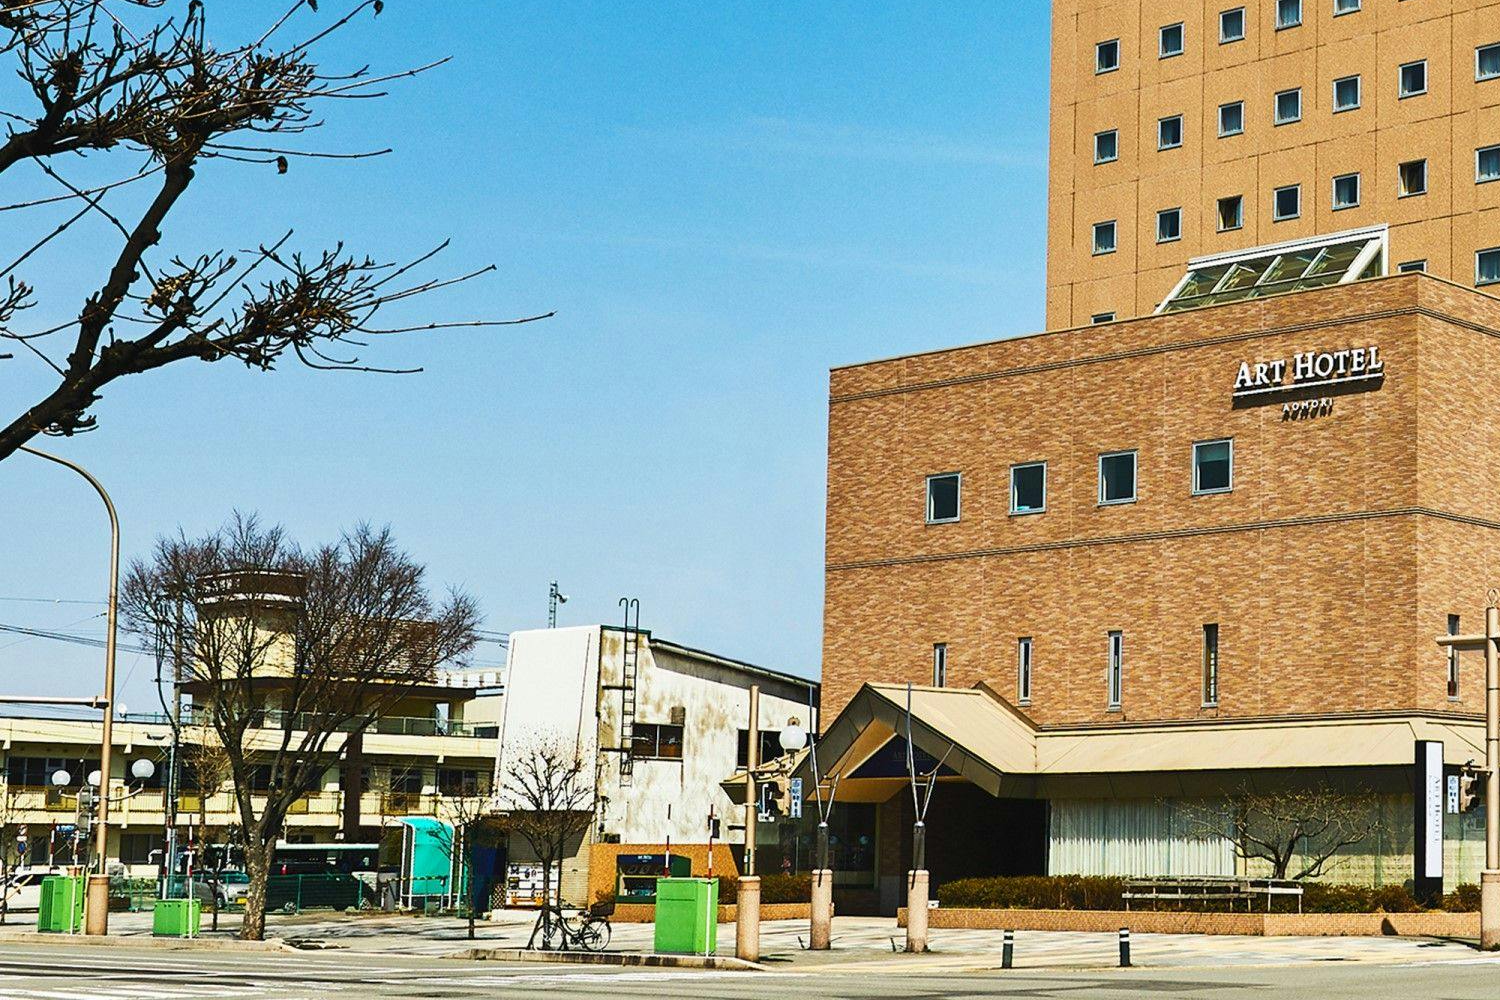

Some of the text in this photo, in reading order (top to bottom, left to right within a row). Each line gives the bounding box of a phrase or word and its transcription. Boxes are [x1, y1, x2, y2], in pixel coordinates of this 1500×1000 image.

[1233, 346, 1384, 388] ART HOTEL
[1283, 398, 1333, 412] AOMORI
